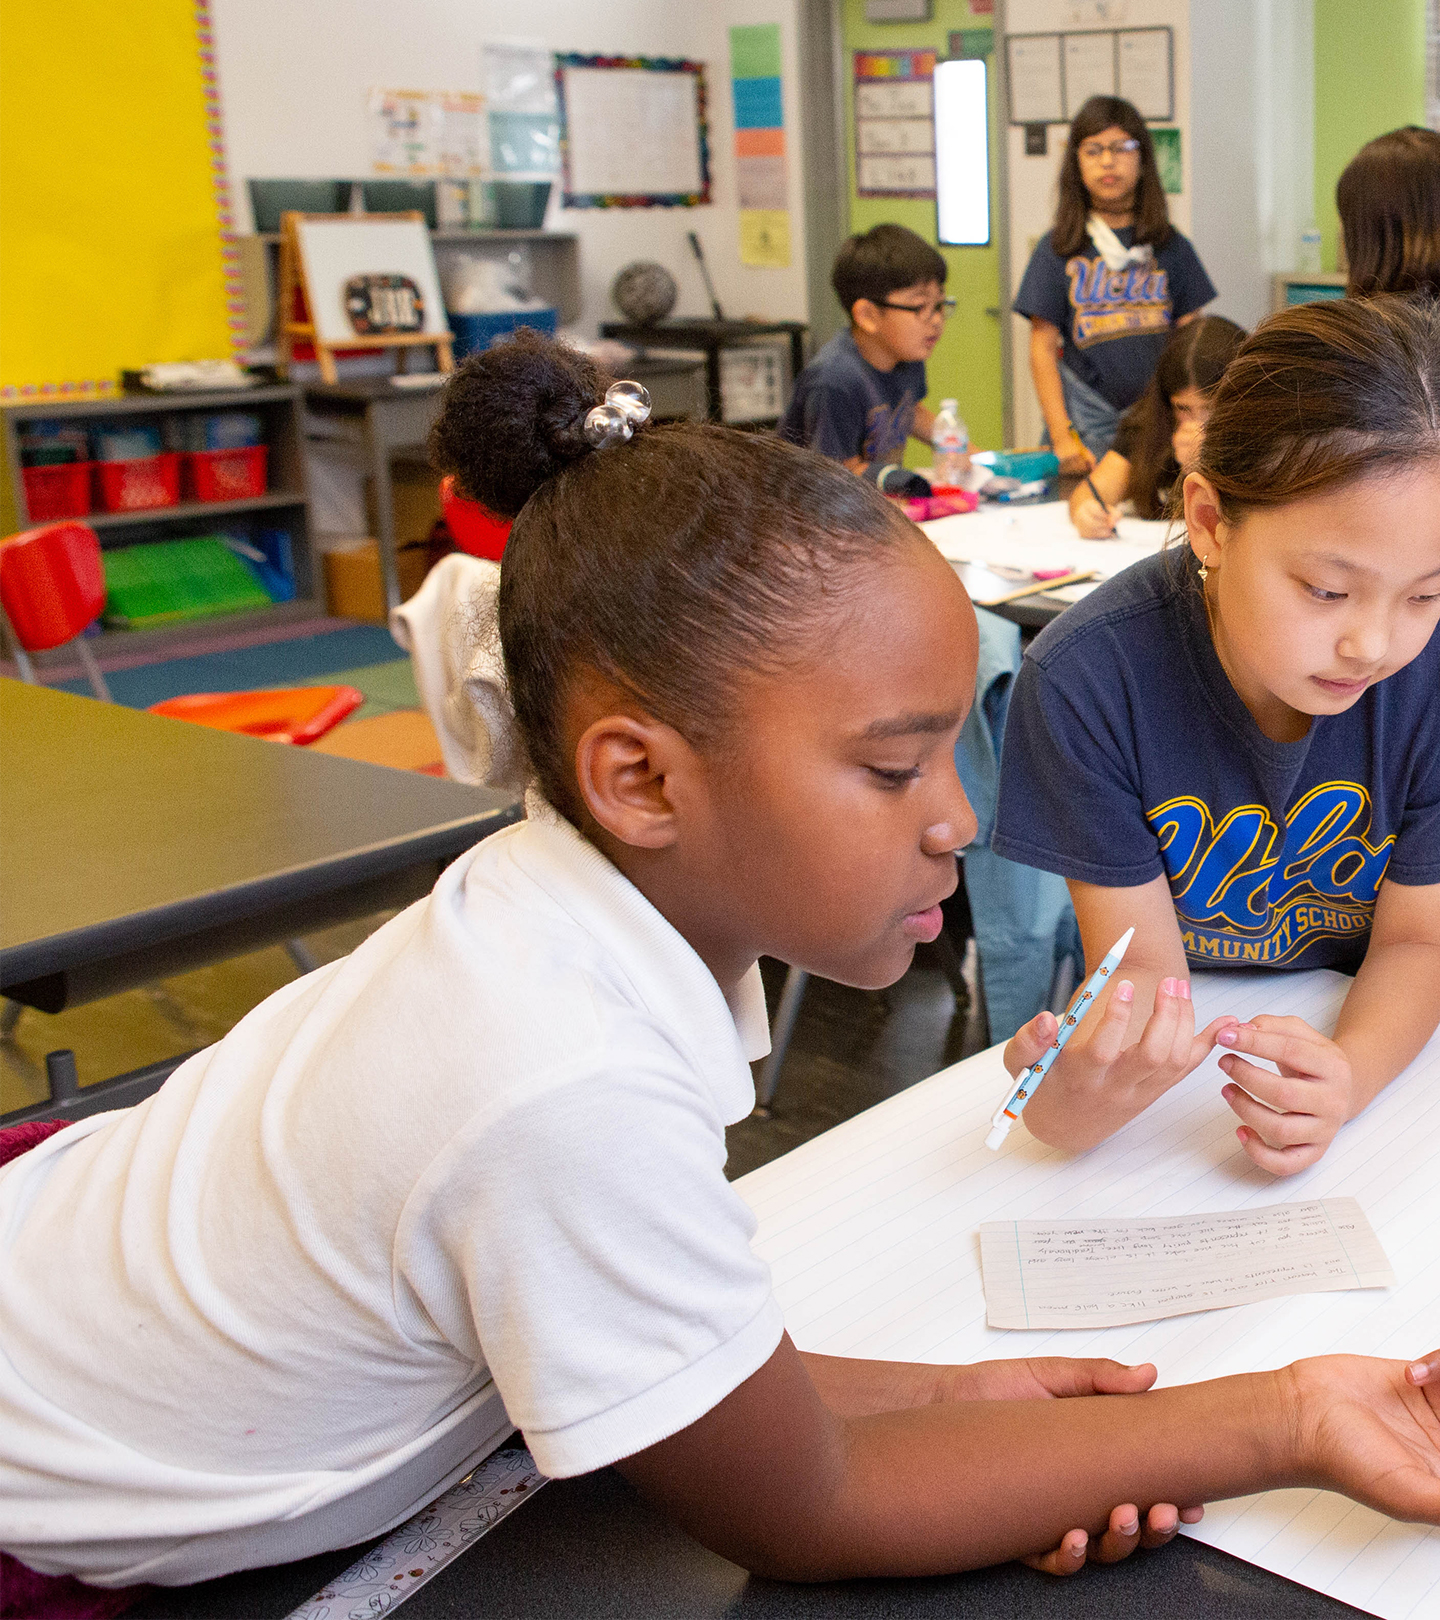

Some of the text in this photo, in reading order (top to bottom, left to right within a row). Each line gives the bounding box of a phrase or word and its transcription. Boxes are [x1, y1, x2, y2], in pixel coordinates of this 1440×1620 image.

[1180, 905, 1374, 961] MMUNITY SCHOO
[1199, 1232, 1248, 1244] represents
